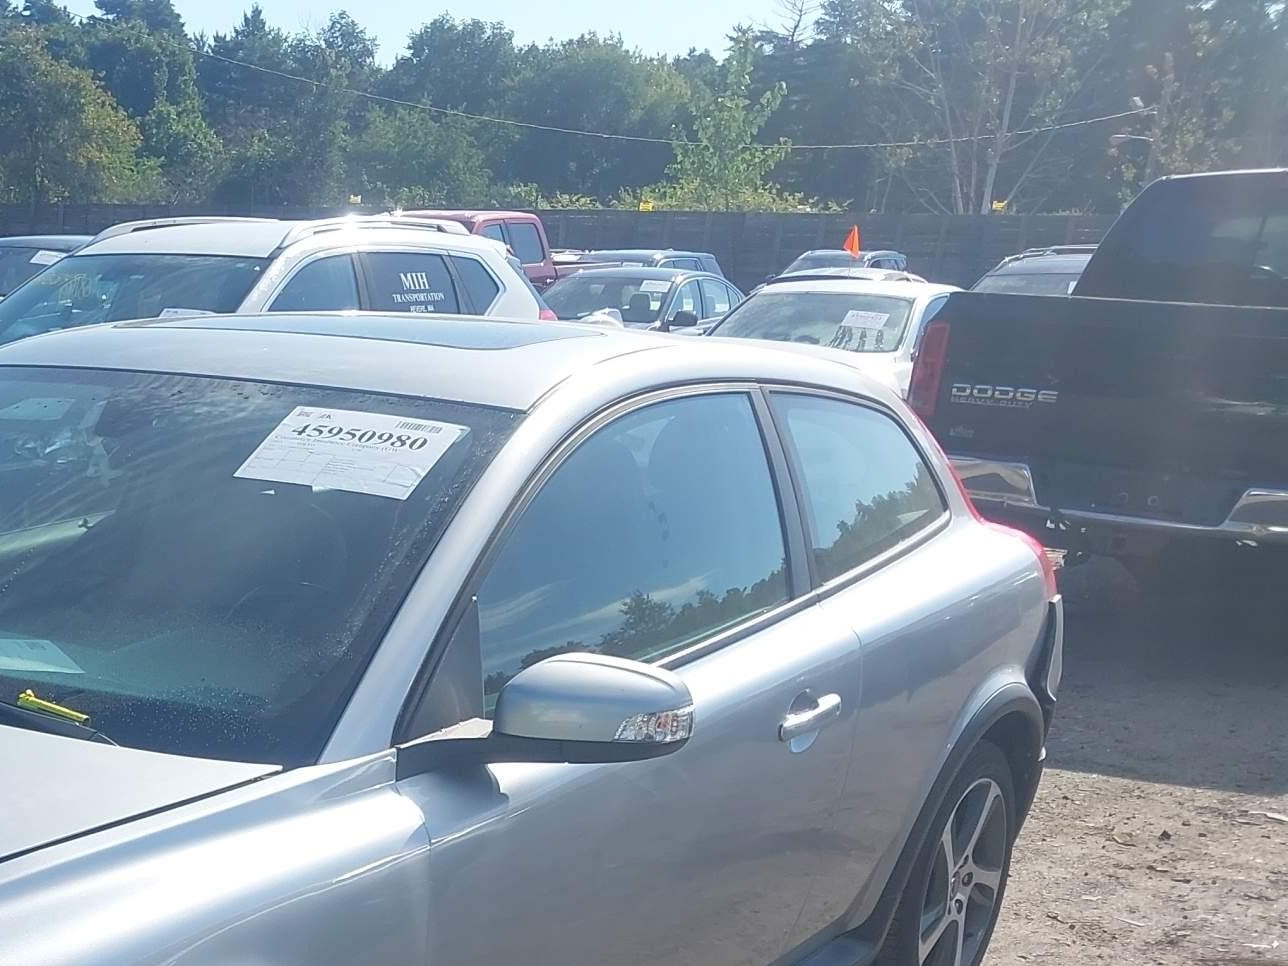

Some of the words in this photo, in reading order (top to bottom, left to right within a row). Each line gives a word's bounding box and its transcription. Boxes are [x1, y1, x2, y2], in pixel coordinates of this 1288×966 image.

[399, 271, 430, 290] MIH
[392, 291, 445, 303] TRANSPORTATION
[951, 383, 1059, 403] DODGE
[291, 422, 429, 451] 45950980
